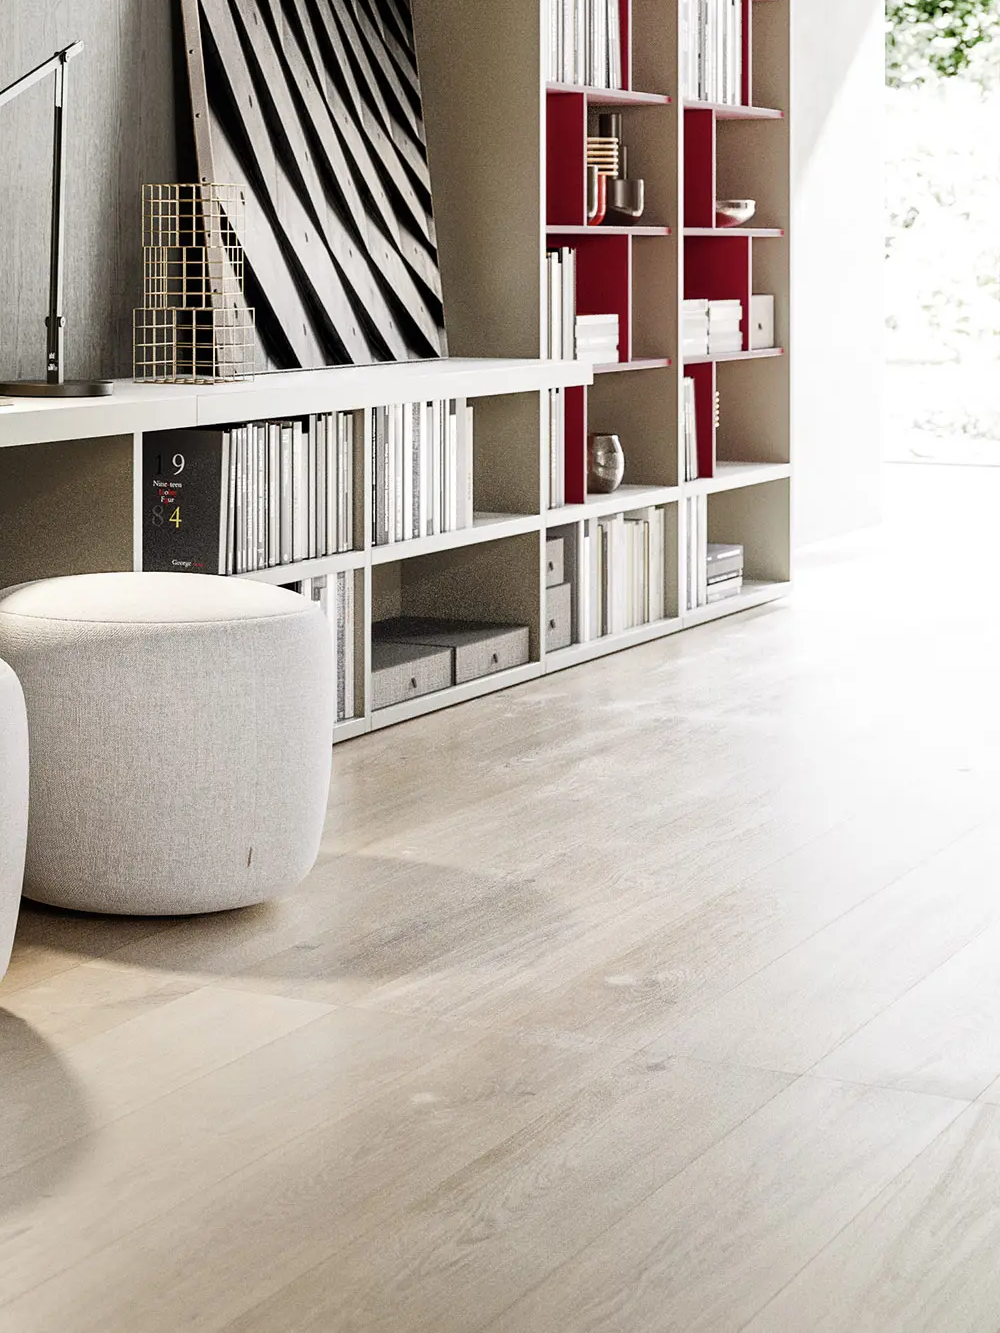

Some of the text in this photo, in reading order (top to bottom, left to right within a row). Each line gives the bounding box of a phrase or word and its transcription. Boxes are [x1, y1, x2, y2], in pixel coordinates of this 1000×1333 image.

[172, 453, 185, 476] 9
[152, 505, 182, 528] 8 4
[171, 559, 191, 568] George
